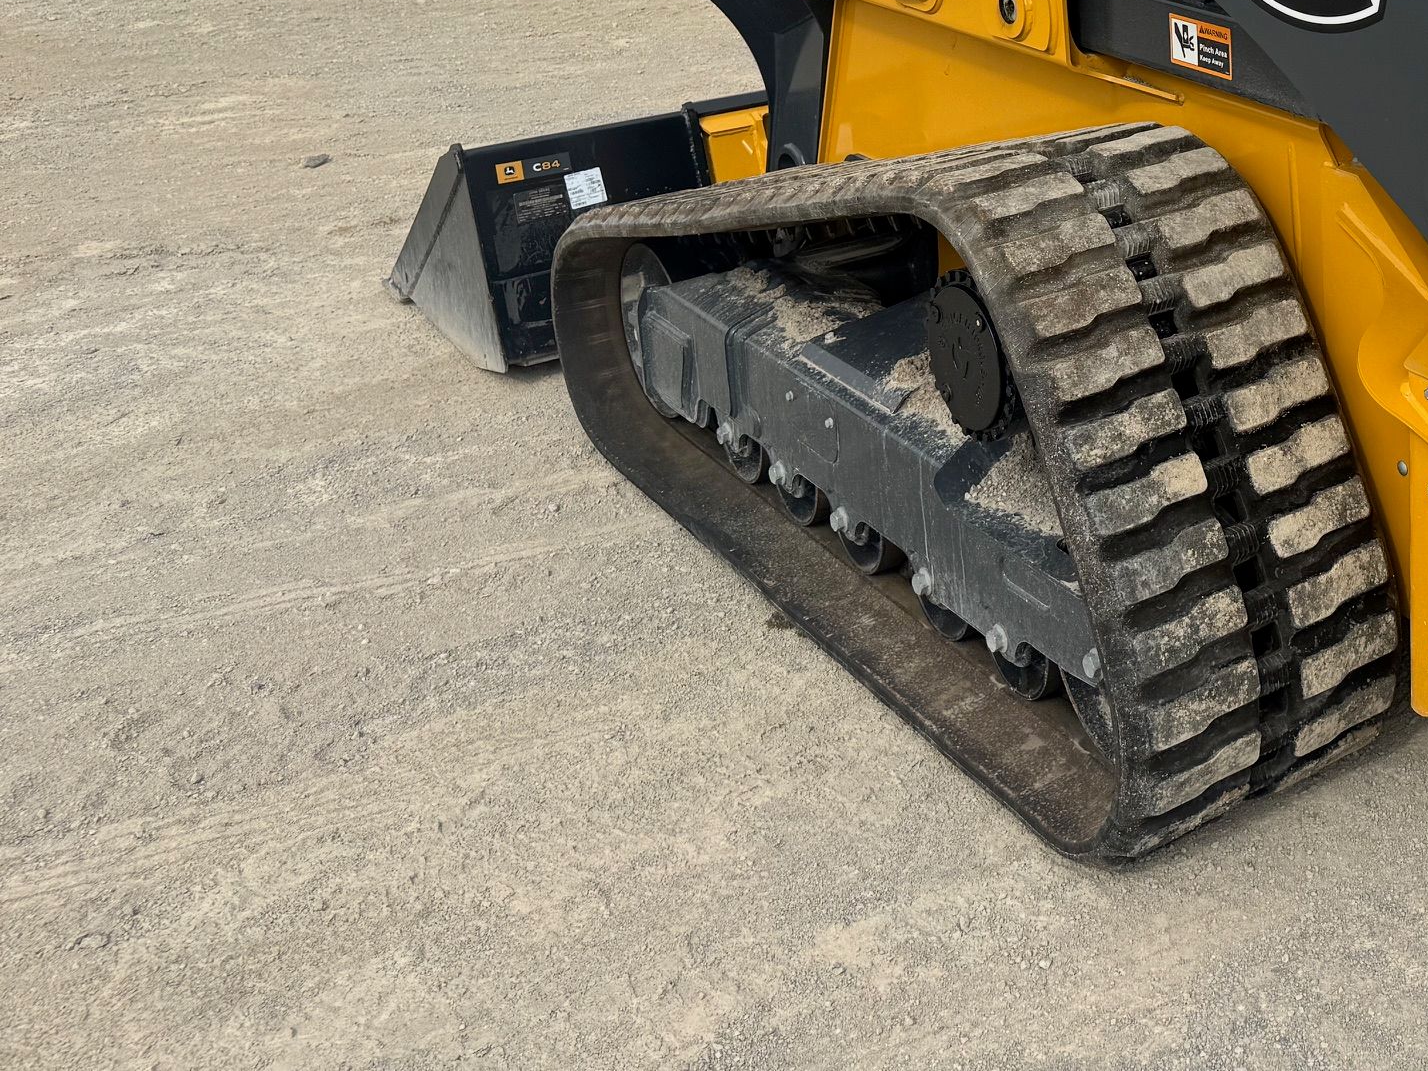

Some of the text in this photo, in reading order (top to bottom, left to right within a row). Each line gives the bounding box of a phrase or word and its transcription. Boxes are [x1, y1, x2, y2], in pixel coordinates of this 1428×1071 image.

[1203, 28, 1228, 40] WARNING
[1199, 43, 1228, 58] Pinch Area
[1200, 55, 1224, 68] Keep Away
[532, 159, 561, 173] C84
